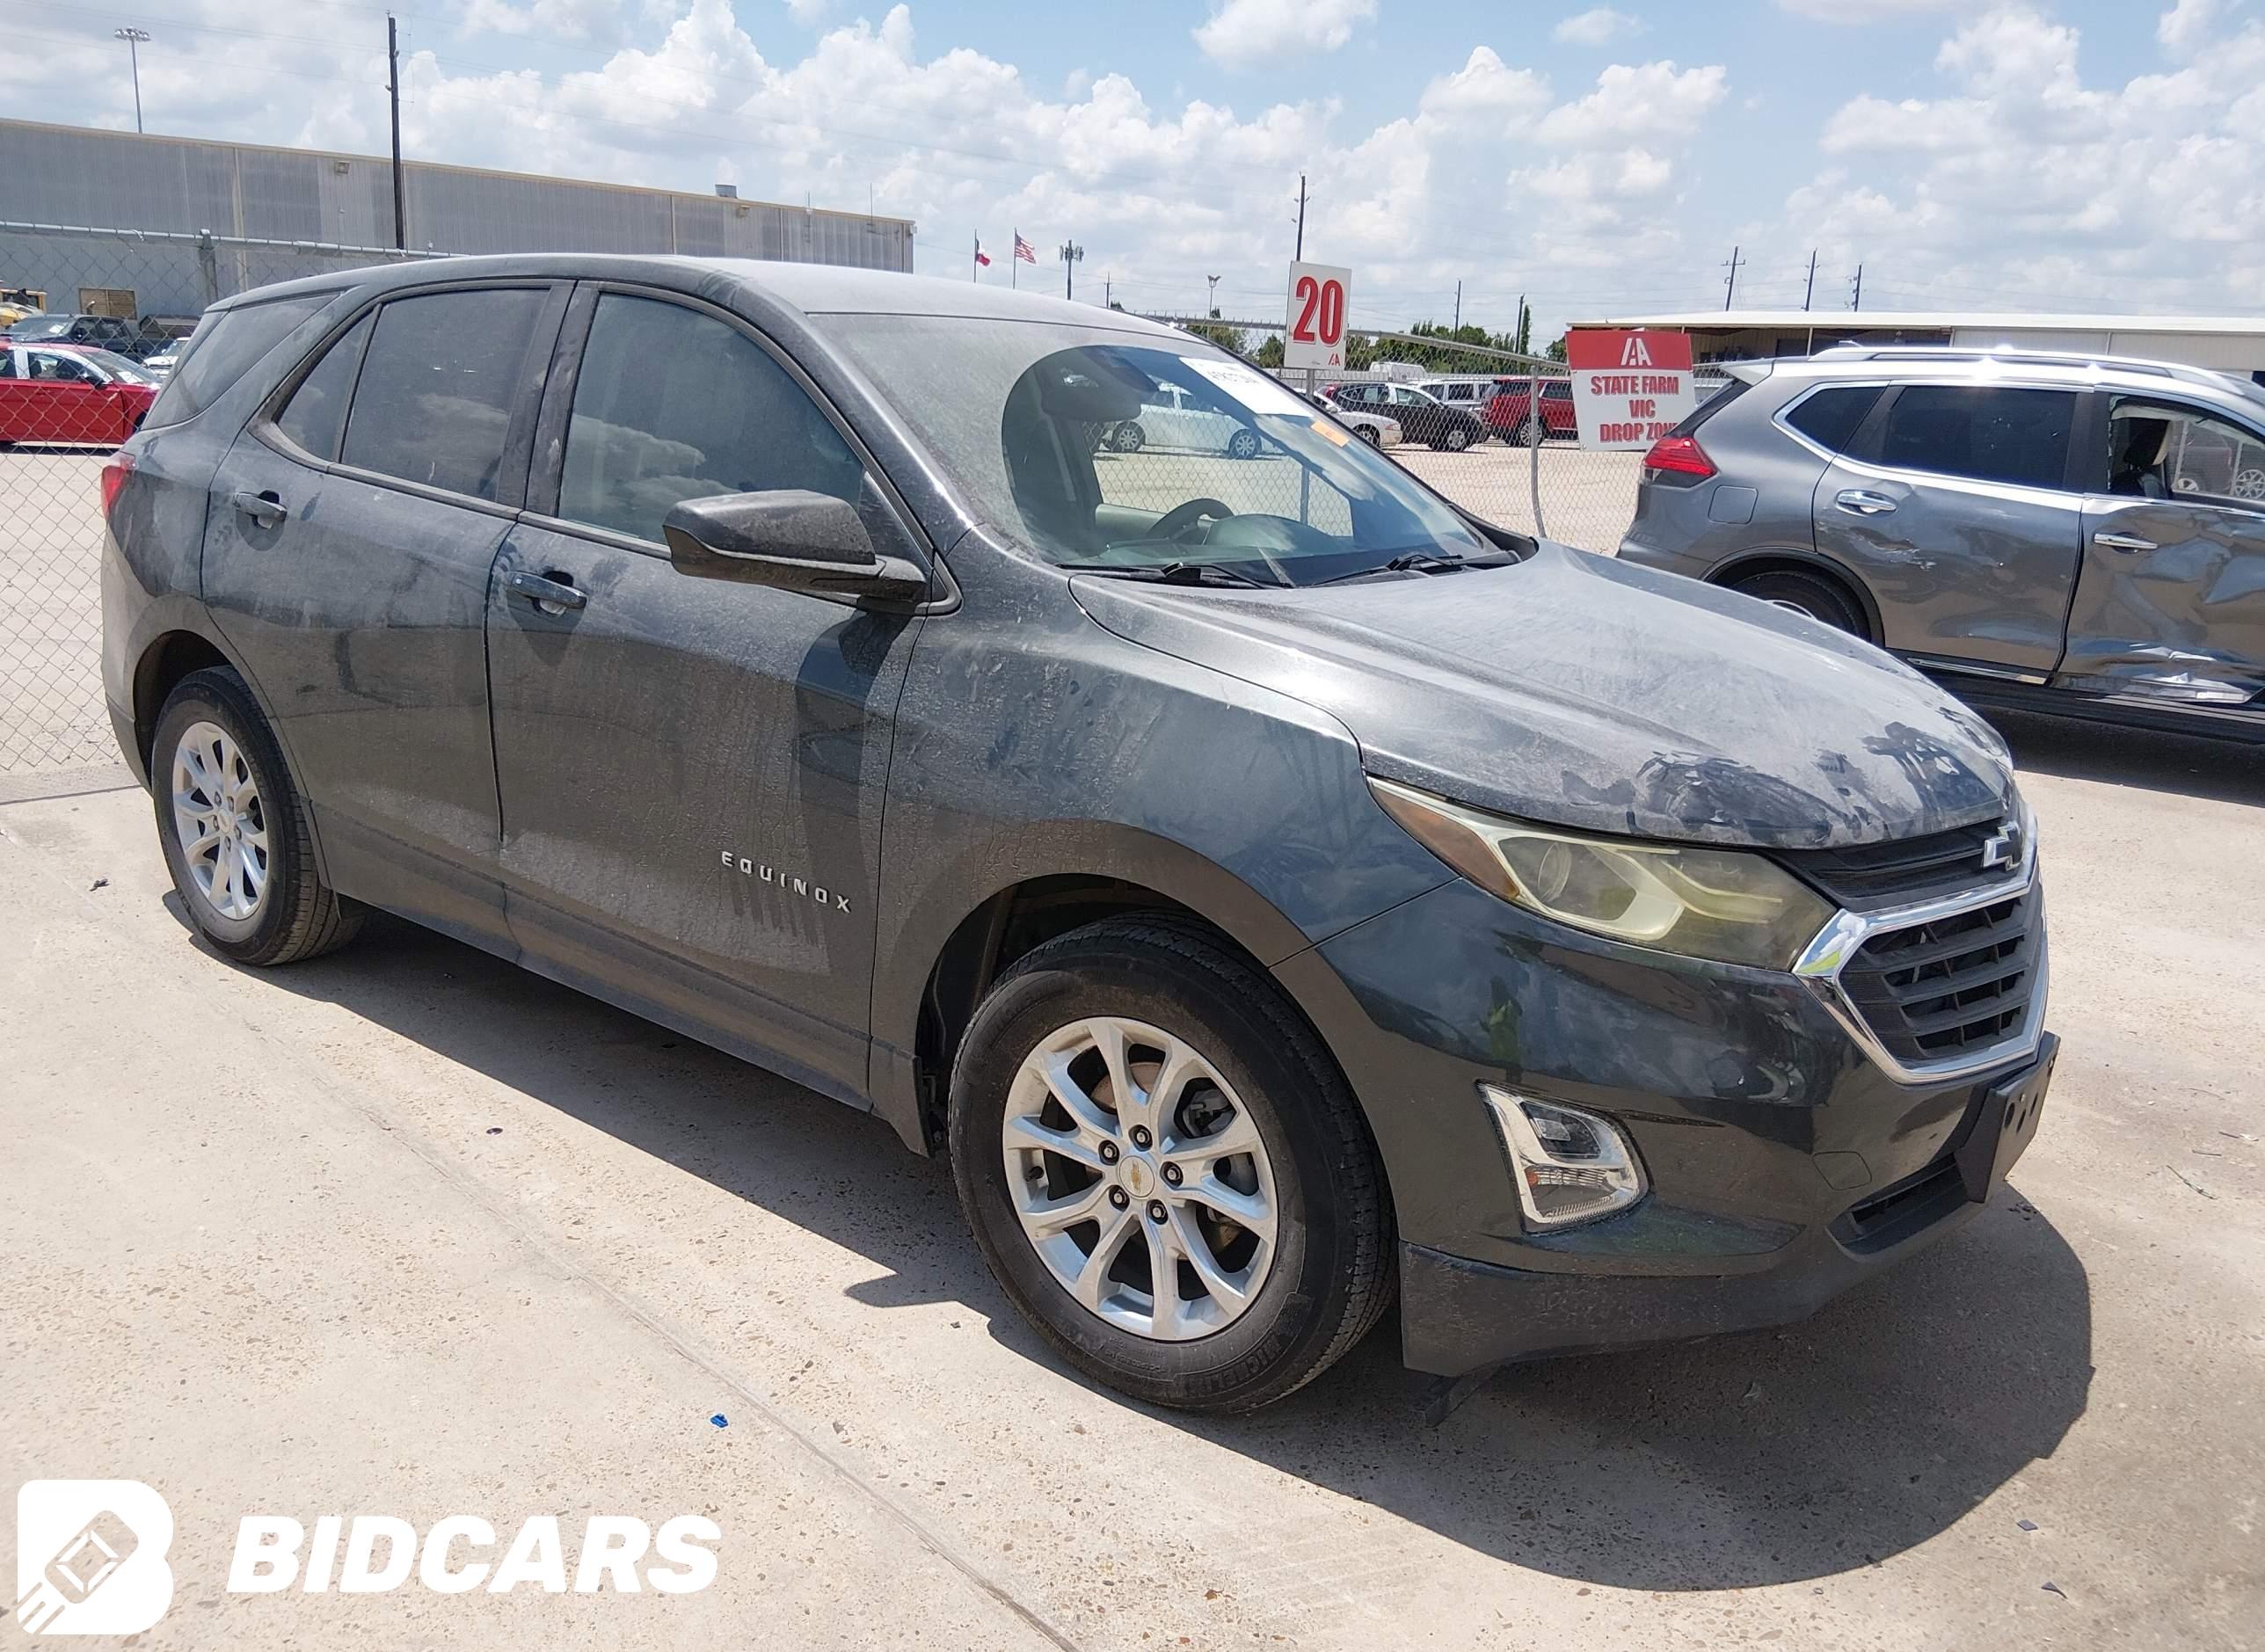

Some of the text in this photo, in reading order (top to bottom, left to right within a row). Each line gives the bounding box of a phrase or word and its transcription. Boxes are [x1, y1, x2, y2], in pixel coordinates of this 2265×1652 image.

[1293, 276, 1344, 347] 20
[1591, 375, 1679, 396] STATE FARM
[1628, 399, 1656, 418] VIC
[1599, 422, 1678, 443] DROP ZON
[721, 851, 851, 913] EQUINOX
